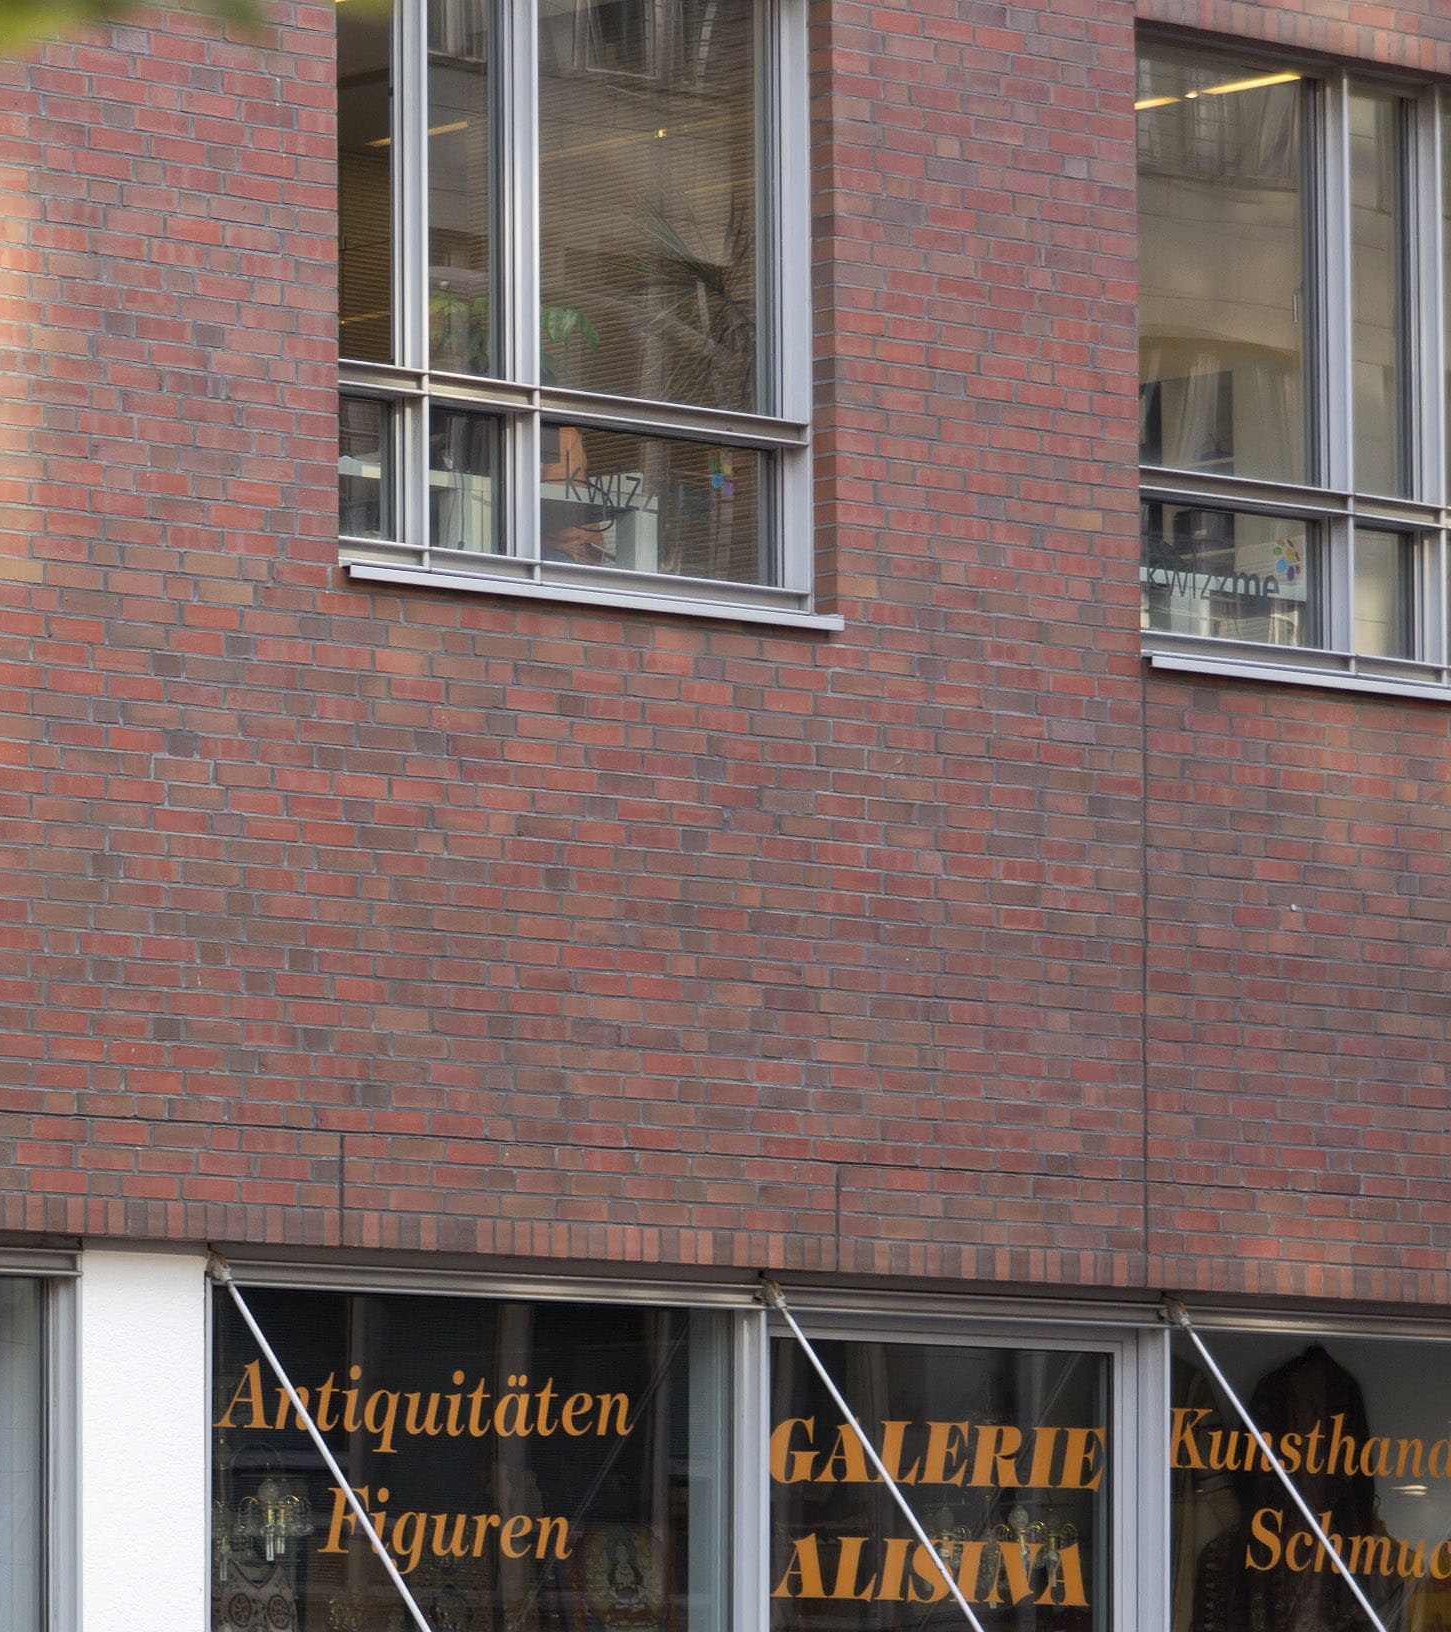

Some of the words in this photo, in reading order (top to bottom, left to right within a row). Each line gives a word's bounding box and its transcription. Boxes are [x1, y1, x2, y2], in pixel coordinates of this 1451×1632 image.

[213, 1359, 634, 1453] Antiquitäten
[769, 1416, 1106, 1492] GALERIE
[318, 1485, 573, 1575] Figuren
[770, 1532, 1090, 1607] ALISINA
